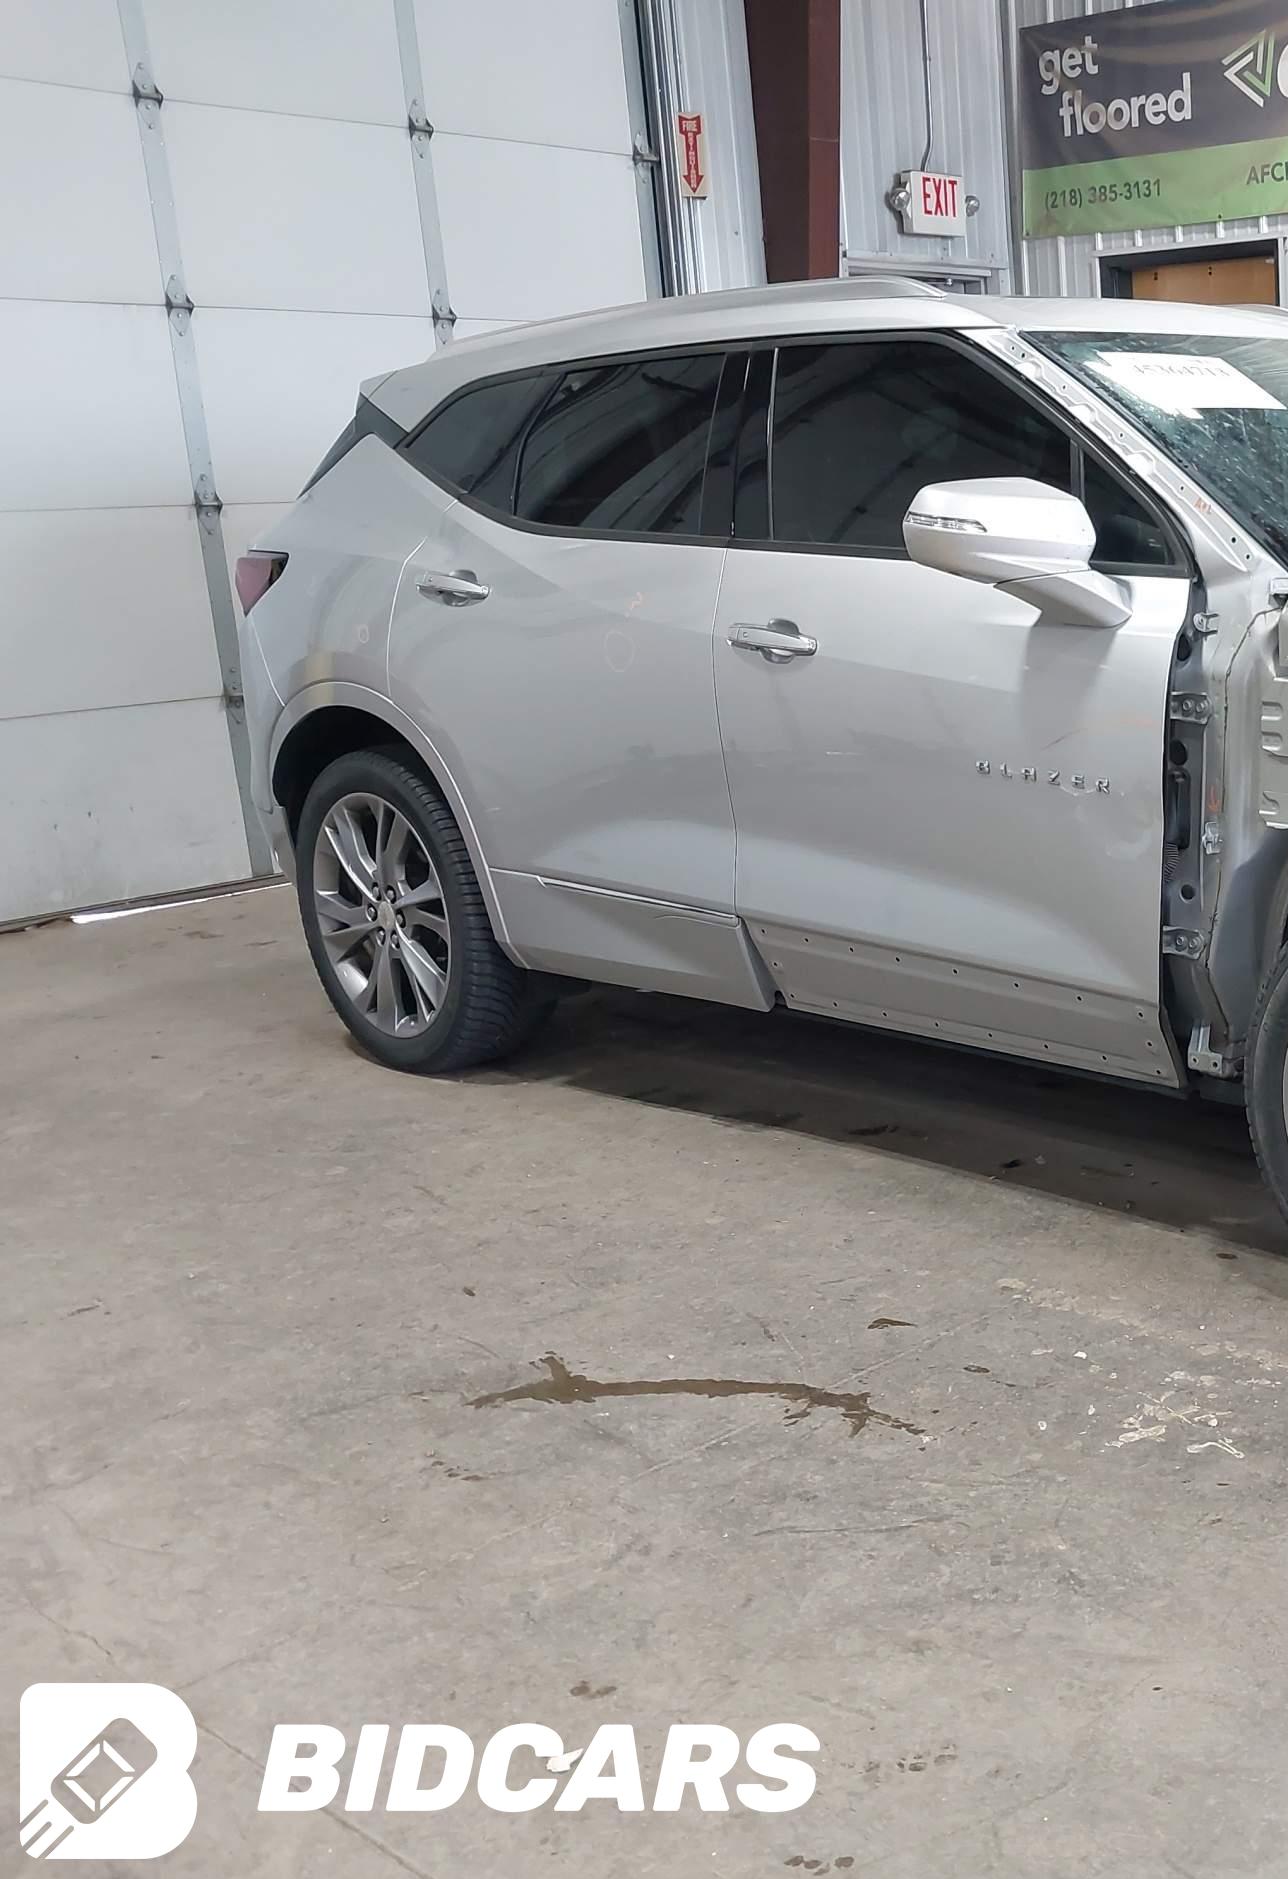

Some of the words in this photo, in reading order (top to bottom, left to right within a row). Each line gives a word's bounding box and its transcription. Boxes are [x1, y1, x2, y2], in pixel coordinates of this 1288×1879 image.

[1038, 35, 1098, 96] get
[1059, 72, 1192, 137] floored
[922, 176, 957, 217] EXIT
[1044, 187, 1083, 211] (218)
[1087, 178, 1161, 205] 385-3131
[975, 760, 1111, 794] BLAZER
